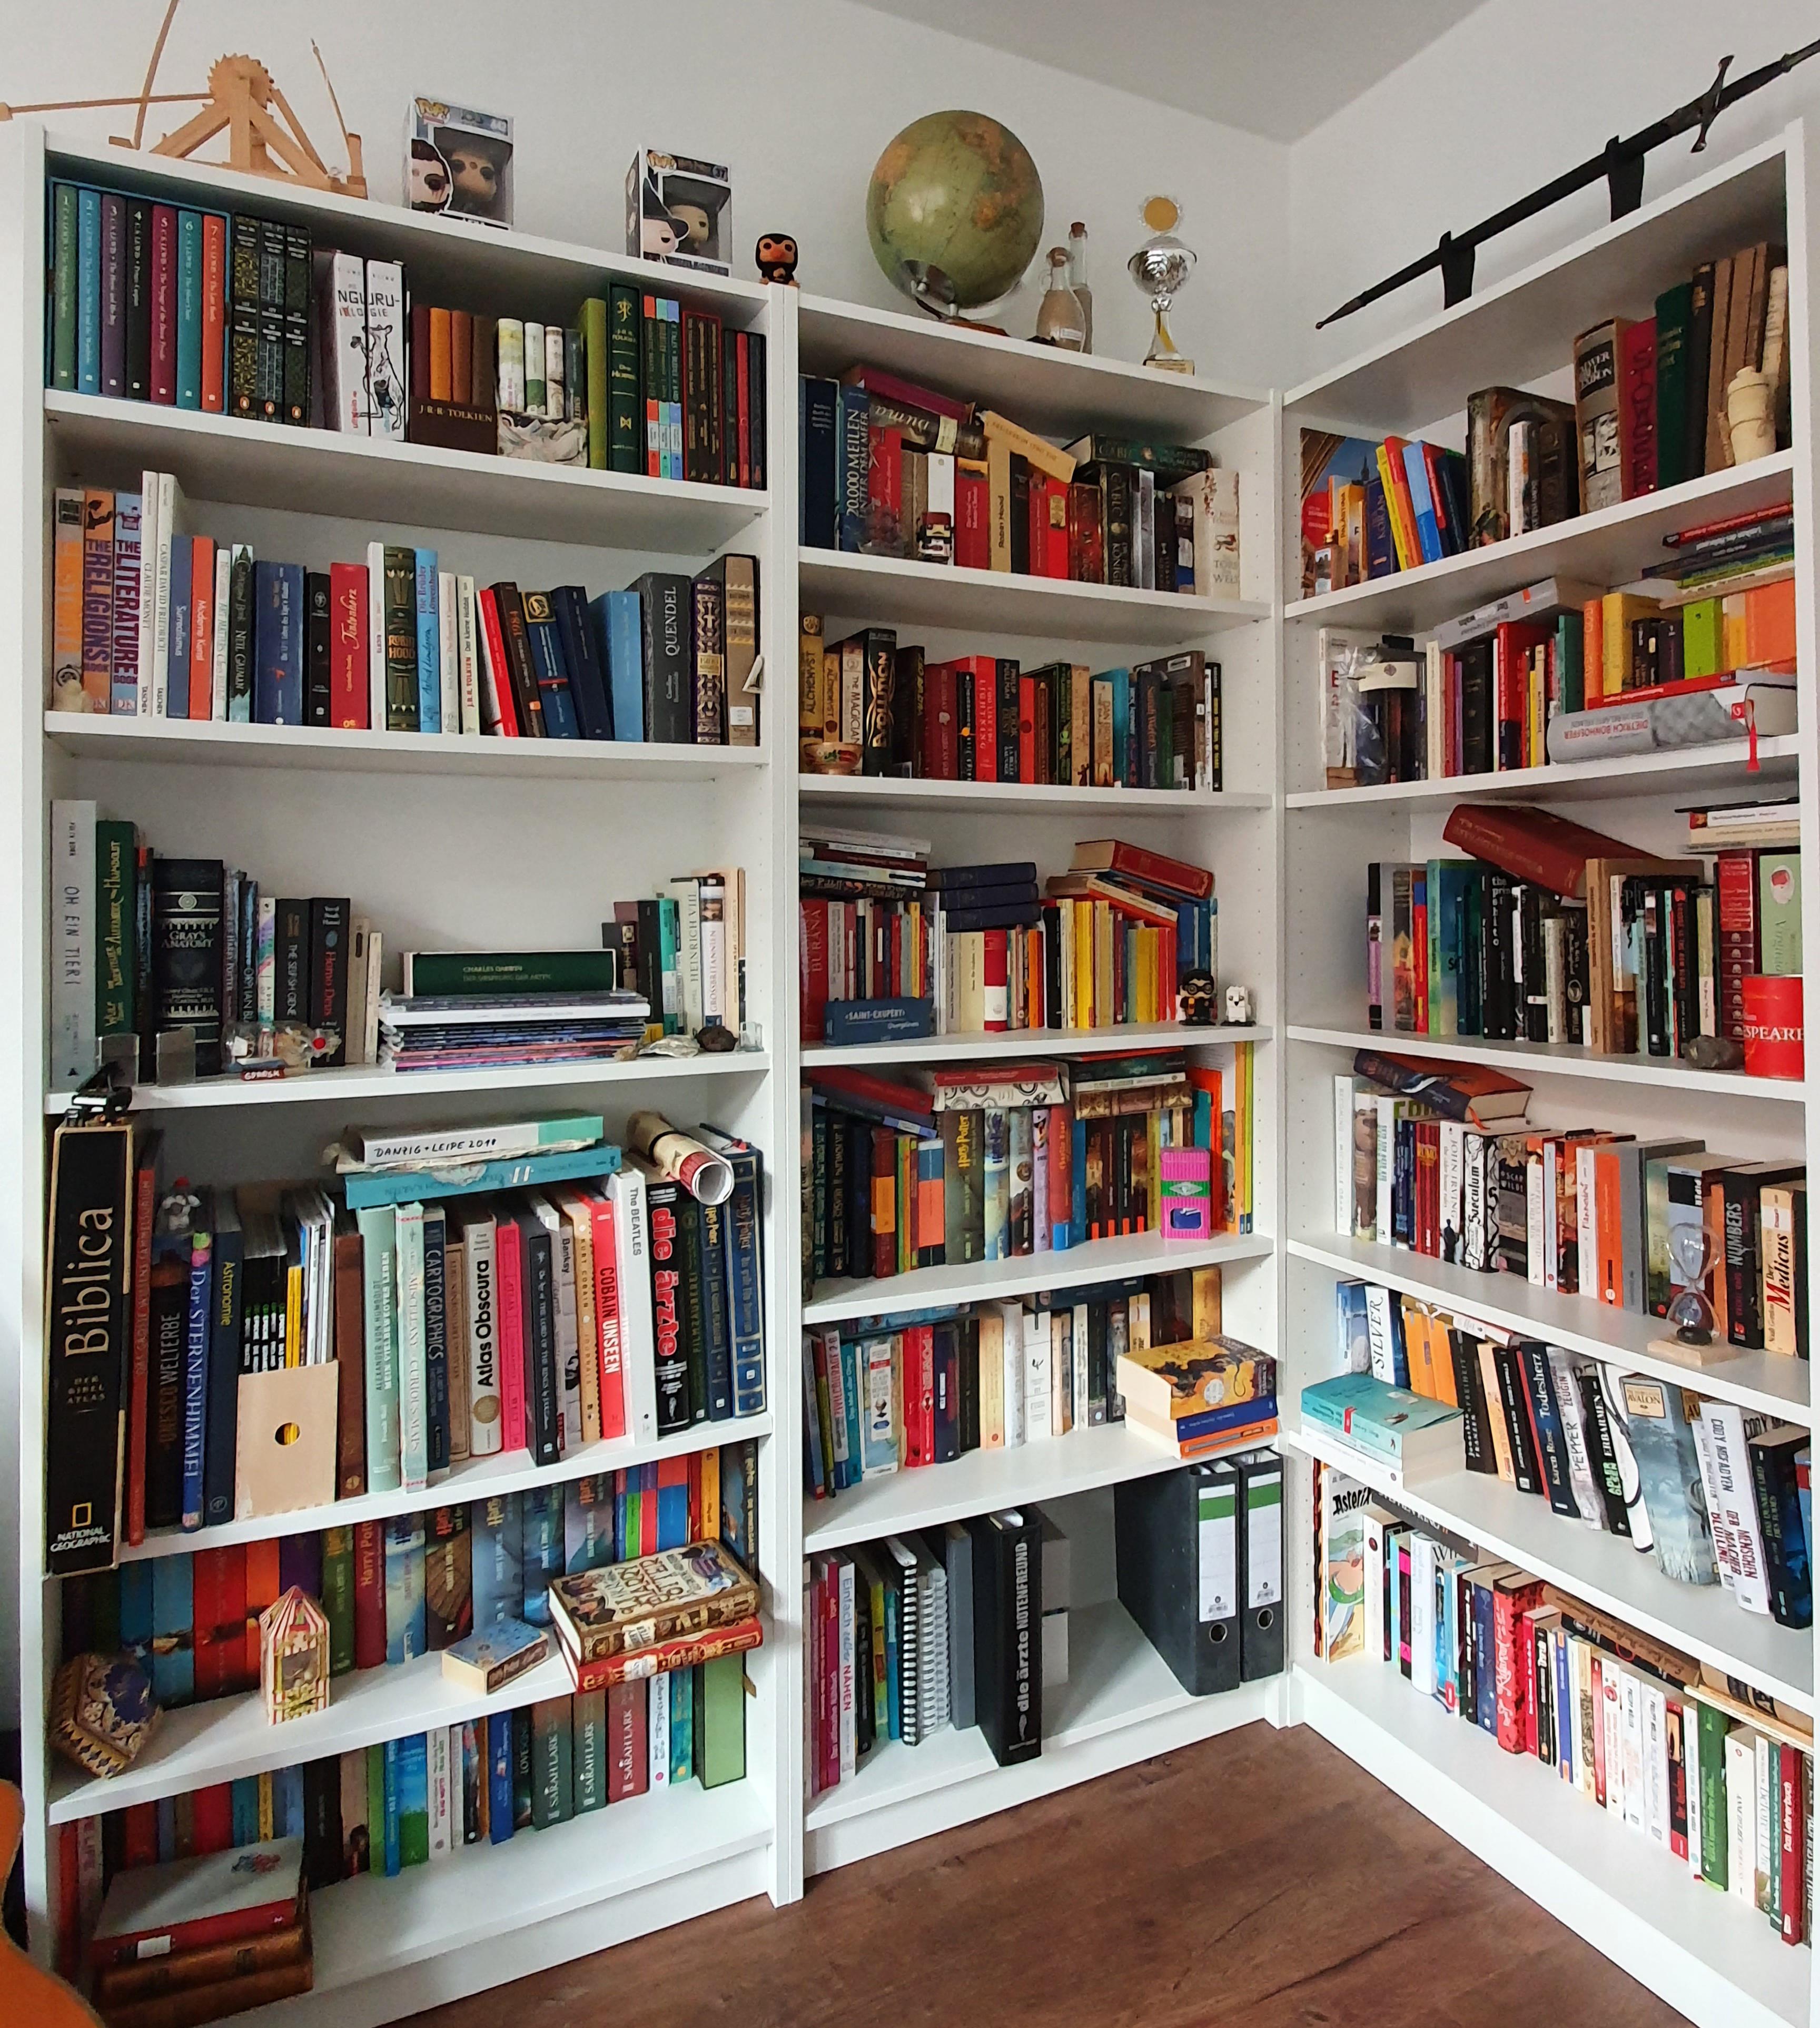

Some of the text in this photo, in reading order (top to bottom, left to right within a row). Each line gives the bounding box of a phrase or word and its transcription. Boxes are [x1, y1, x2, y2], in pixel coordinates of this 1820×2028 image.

[448, 408, 493, 422] TOLKIEN
[875, 405, 930, 430] Duma
[846, 408, 859, 517] 20.000 MEILEN
[88, 539, 111, 553] THE
[116, 539, 141, 553] THE
[160, 543, 169, 576] CASPAR
[143, 563, 152, 597] CLAUDE
[159, 578, 167, 604] DAVID
[428, 565, 436, 615] Löwenherz
[85, 553, 111, 663] RELIGIONS
[114, 553, 140, 676] LITERATURE
[142, 599, 151, 629] MONET
[157, 607, 166, 652] FRIEDRICH
[174, 605, 187, 657] Surrealismus
[195, 599, 206, 661] Moderne Kunst
[341, 588, 360, 649] Tintenherz
[510, 610, 520, 637] 1984
[665, 585, 677, 657] QUENDEL
[234, 629, 247, 688] NEIL GAIMAN
[388, 635, 414, 646] ROBIN
[388, 647, 414, 658] HOOD
[65, 915, 80, 937] EIN
[688, 920, 698, 982] HEINRICH
[811, 909, 822, 972] BURANA
[226, 936, 235, 991] HARRY POTTER
[286, 944, 298, 1016] THE SELFISH GENE
[323, 951, 337, 1016] Homo Deus
[374, 1145, 421, 1157] DANZIG
[1500, 1170, 1524, 1182] OSCAR
[630, 1187, 641, 1256] The BEATLES
[1449, 1175, 1458, 1218] IRVING
[561, 1238, 571, 1273] Banksy
[1726, 1202, 1742, 1266] NUMBERS
[62, 1206, 113, 1358] Biblica
[221, 1262, 236, 1326] Astronomie
[651, 1207, 679, 1356] die ärzte
[1766, 1234, 1791, 1313] Der Medicus
[426, 1249, 444, 1360] CARTOGRAPHICS
[474, 1260, 493, 1387] Atlas Obscura
[600, 1267, 619, 1374] COBAIN UNSEEN
[374, 1325, 382, 1342] VON
[1372, 1296, 1384, 1370] SILVER
[157, 1312, 181, 1443] UNESCO WELTERBE
[183, 1270, 206, 1479] Der STERNENHIMMEL
[374, 1344, 383, 1391] ALEXANDER
[922, 1338, 933, 1391] POWER
[1532, 1353, 1549, 1419] Todesherz
[1559, 1376, 1573, 1406] ZEUGIN
[1594, 1395, 1613, 1456] ERBARMEN
[1627, 1393, 1661, 1405] AVALON
[1711, 1419, 1726, 1442] CODY
[1332, 1486, 1371, 1515] Asterix
[50, 1533, 111, 1553] GEOGRAPHIC
[57, 1526, 105, 1542] NATIONAL
[1736, 1530, 1757, 1579] MENSCHEN
[360, 1550, 373, 1586] Harry
[843, 1577, 853, 1628] Einfach
[1015, 1542, 1029, 1712] die ärzte NOTENFREUND
[843, 1665, 852, 1711] NÄHEN
[548, 1734, 558, 1807] SARAH LARK
[584, 1722, 594, 1794] SARAH LARK
[623, 1709, 633, 1780] SARAH LARK
[1783, 1781, 1792, 1852] Das Lehrerbuch
